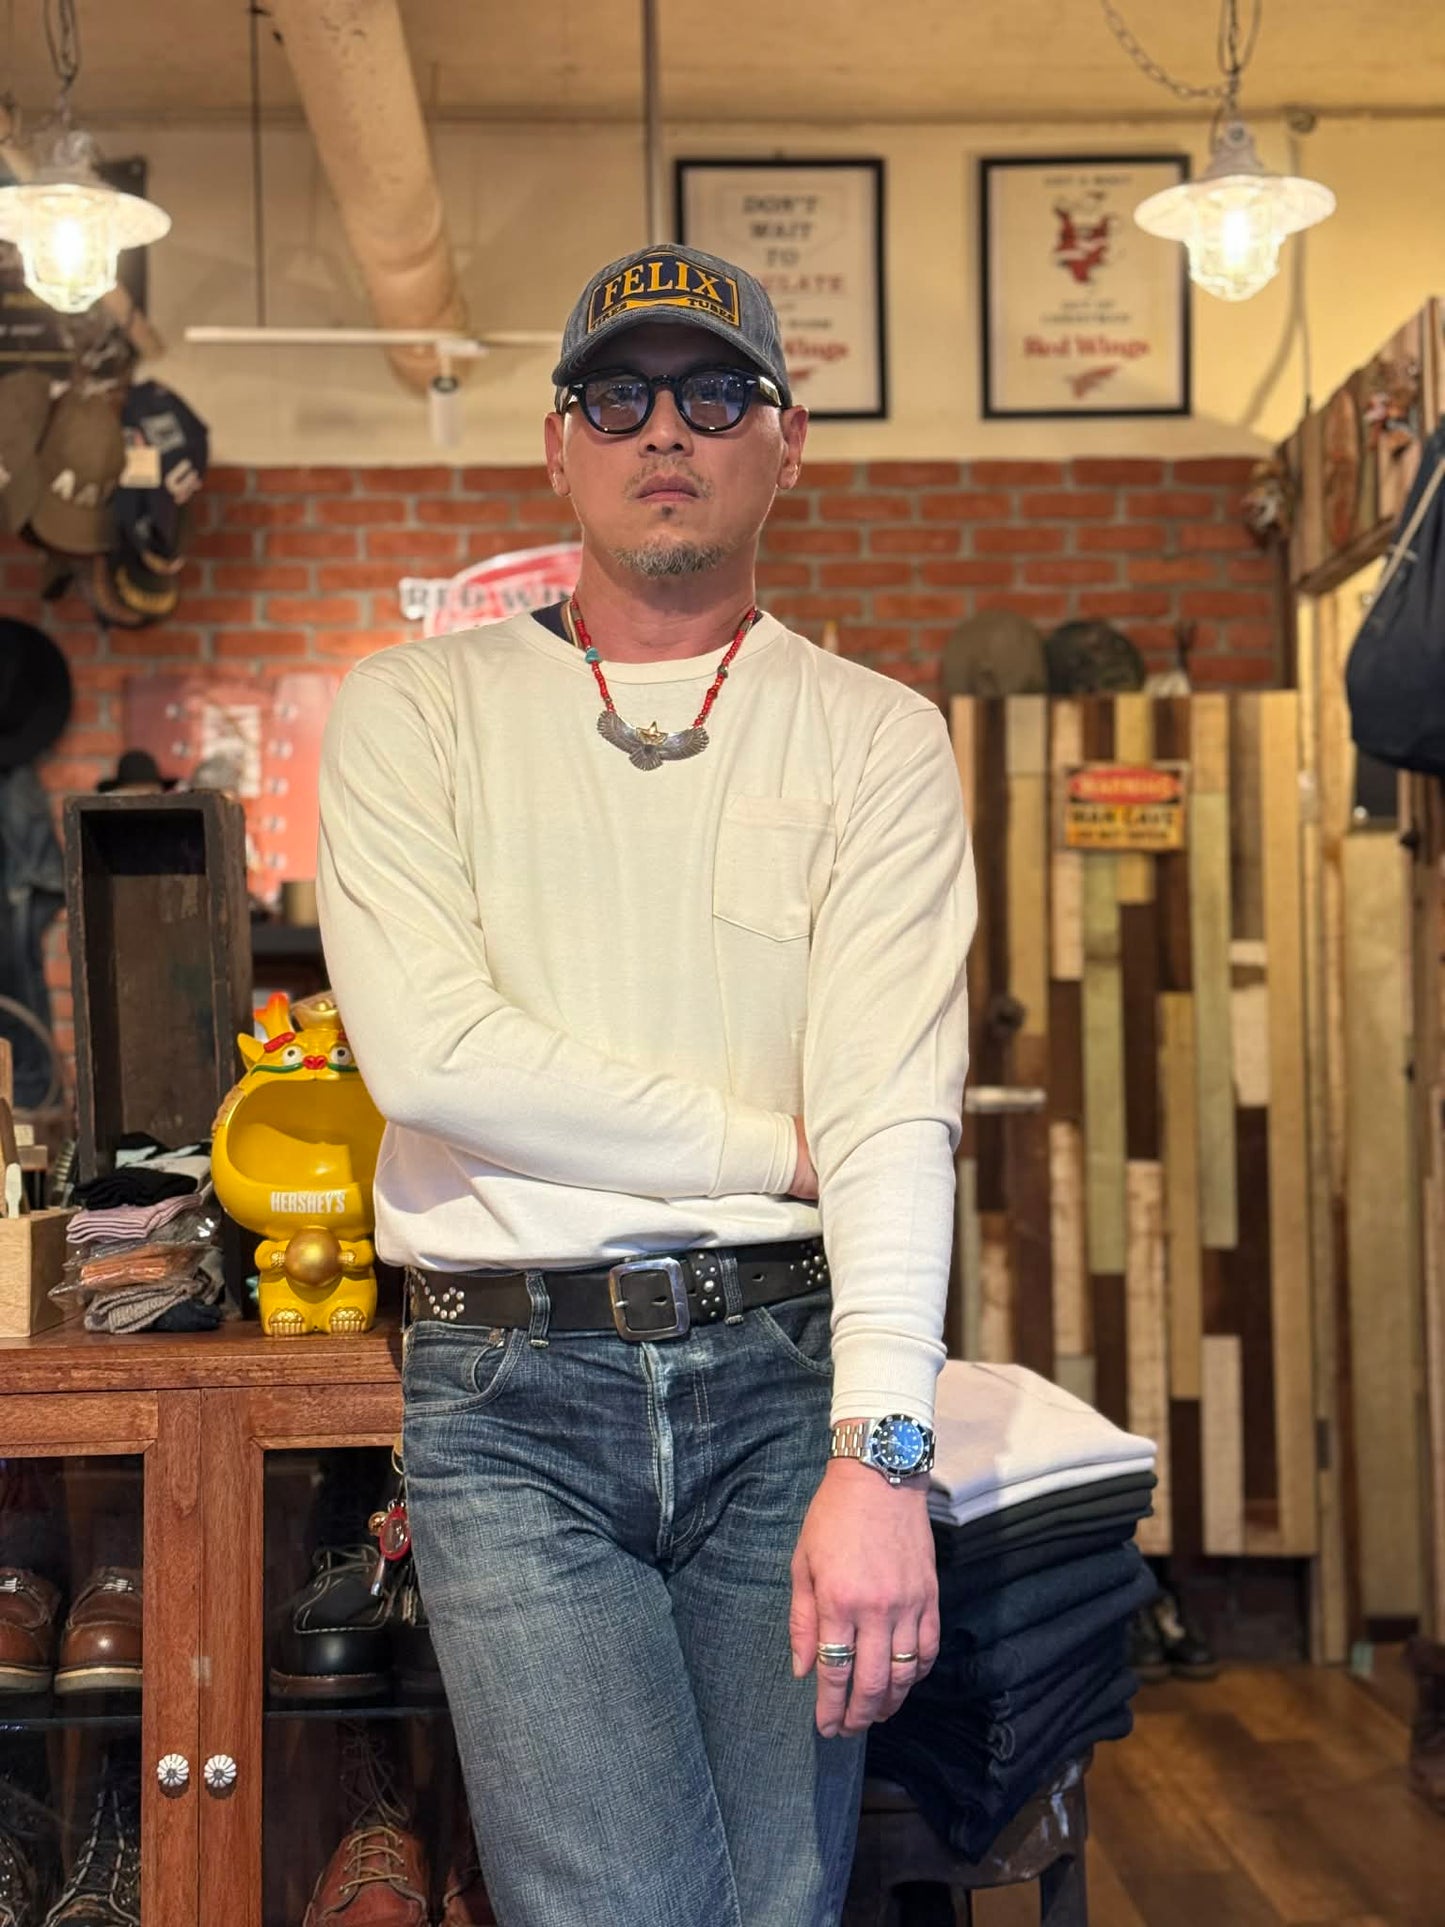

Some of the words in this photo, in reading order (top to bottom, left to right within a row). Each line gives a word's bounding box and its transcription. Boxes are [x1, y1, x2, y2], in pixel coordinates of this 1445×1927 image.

[751, 220, 813, 239] WAIT
[602, 261, 723, 311] FELIX
[687, 298, 736, 323] TUBES
[1023, 336, 1070, 358] Red
[271, 1190, 346, 1214] HERSHEY'S
